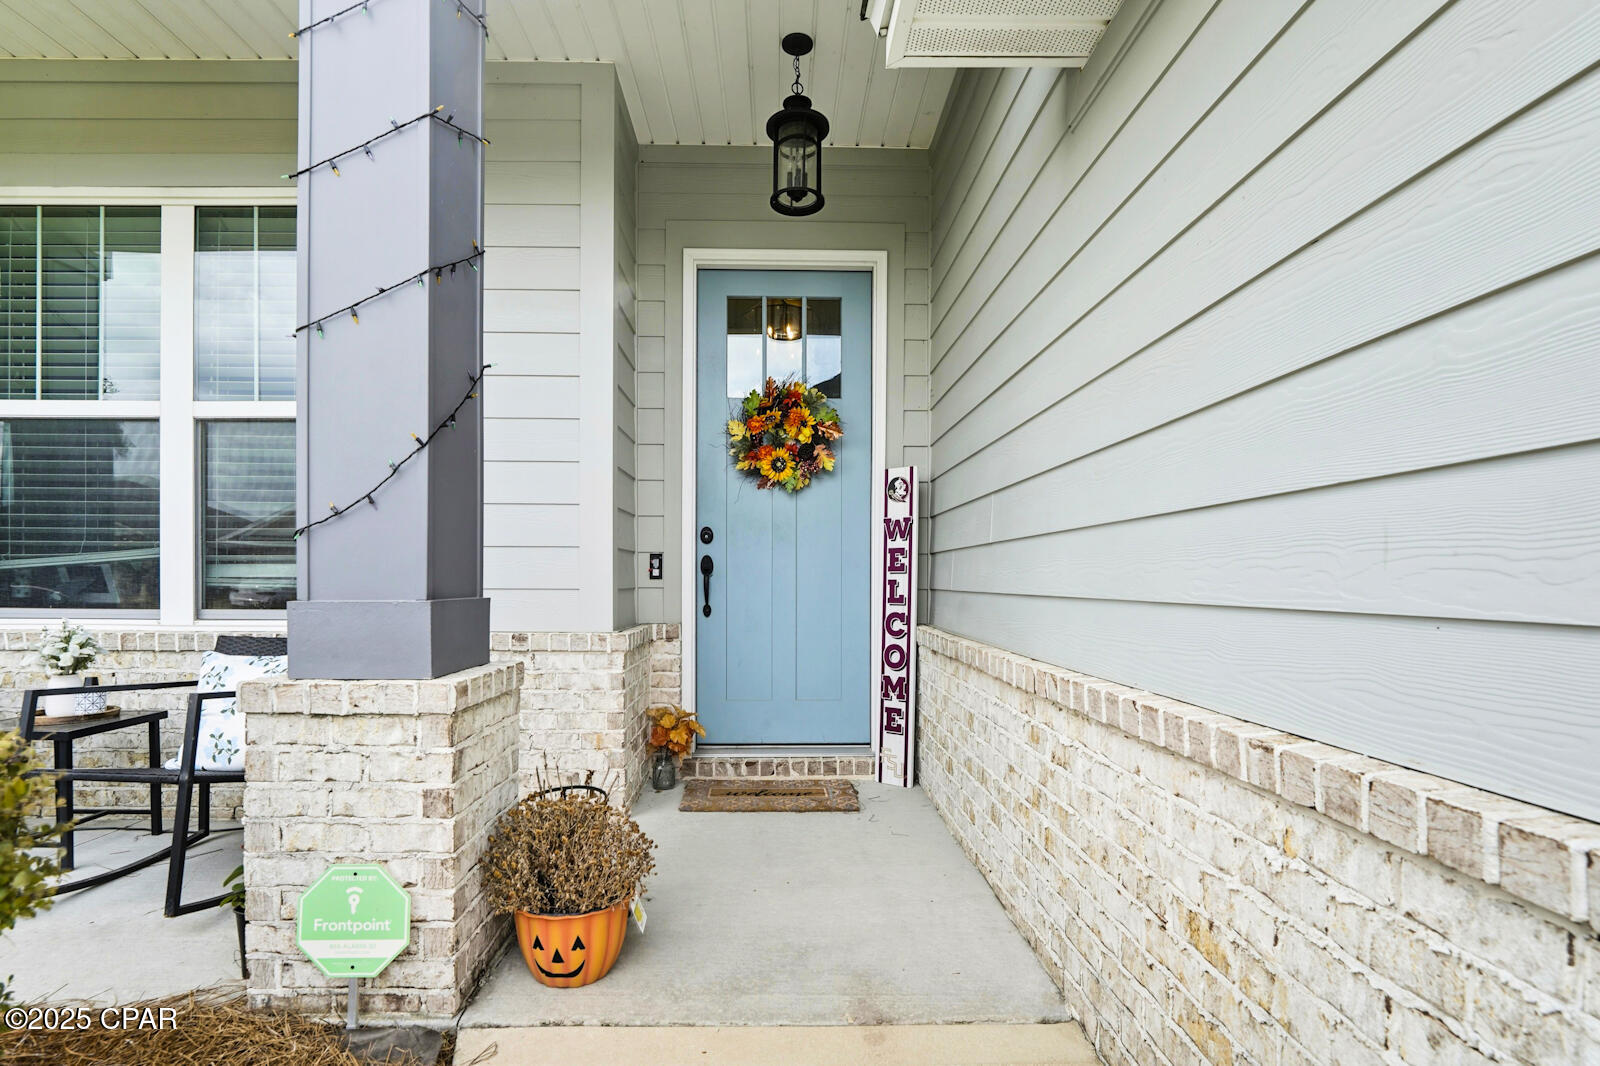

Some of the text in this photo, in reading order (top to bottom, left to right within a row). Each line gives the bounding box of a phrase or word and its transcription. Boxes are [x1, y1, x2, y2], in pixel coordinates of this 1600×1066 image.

[882, 517, 913, 735] WELCOME
[724, 788, 813, 797] welcome
[313, 918, 391, 934] Frontpoint
